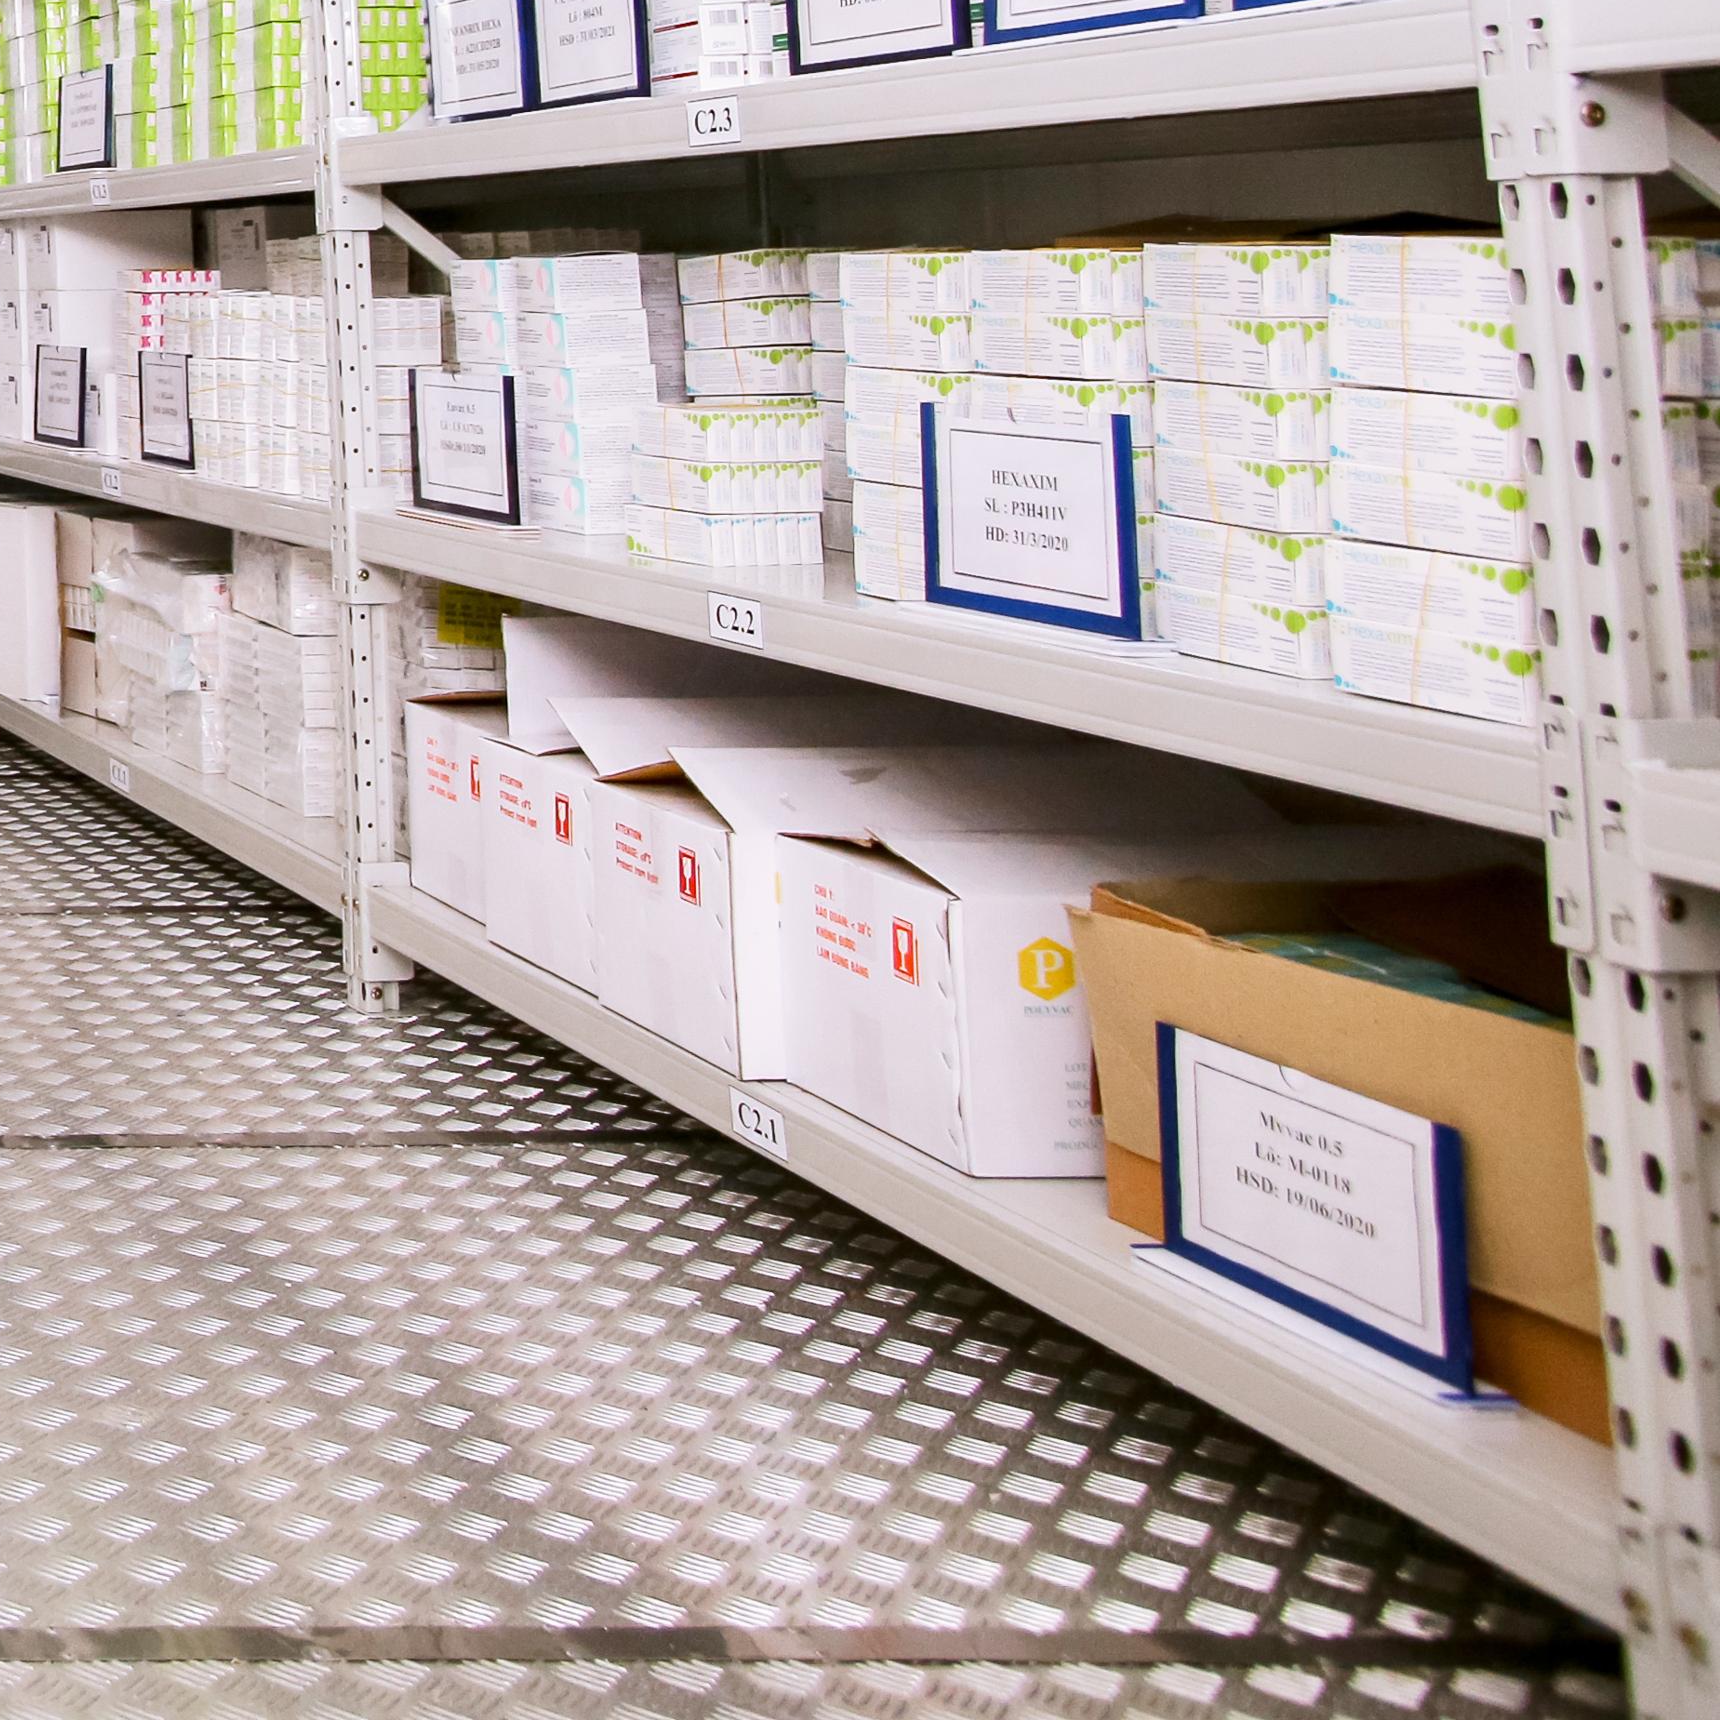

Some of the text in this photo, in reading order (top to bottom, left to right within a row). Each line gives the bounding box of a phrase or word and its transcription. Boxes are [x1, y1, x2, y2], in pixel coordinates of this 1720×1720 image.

[694, 107, 732, 135] C2.3
[1347, 241, 1413, 258] Hexaxim
[1346, 314, 1412, 331] Hexaxim
[1346, 392, 1408, 411] Hexaxim
[991, 469, 1059, 492] HEXAXIM
[983, 497, 1067, 521] SL P3H411V
[985, 525, 1069, 552] HD: 31/3/2020
[1343, 547, 1409, 568] Hexaxim
[716, 604, 755, 635] C2.2
[1022, 1004, 1075, 1018] POLYVAC
[738, 1102, 778, 1144] C2.1
[1259, 1111, 1343, 1159] Mvvac 0.5
[1254, 1140, 1352, 1195] Lô: M-0118
[1235, 1164, 1376, 1239] HSD: 19/06/2020
